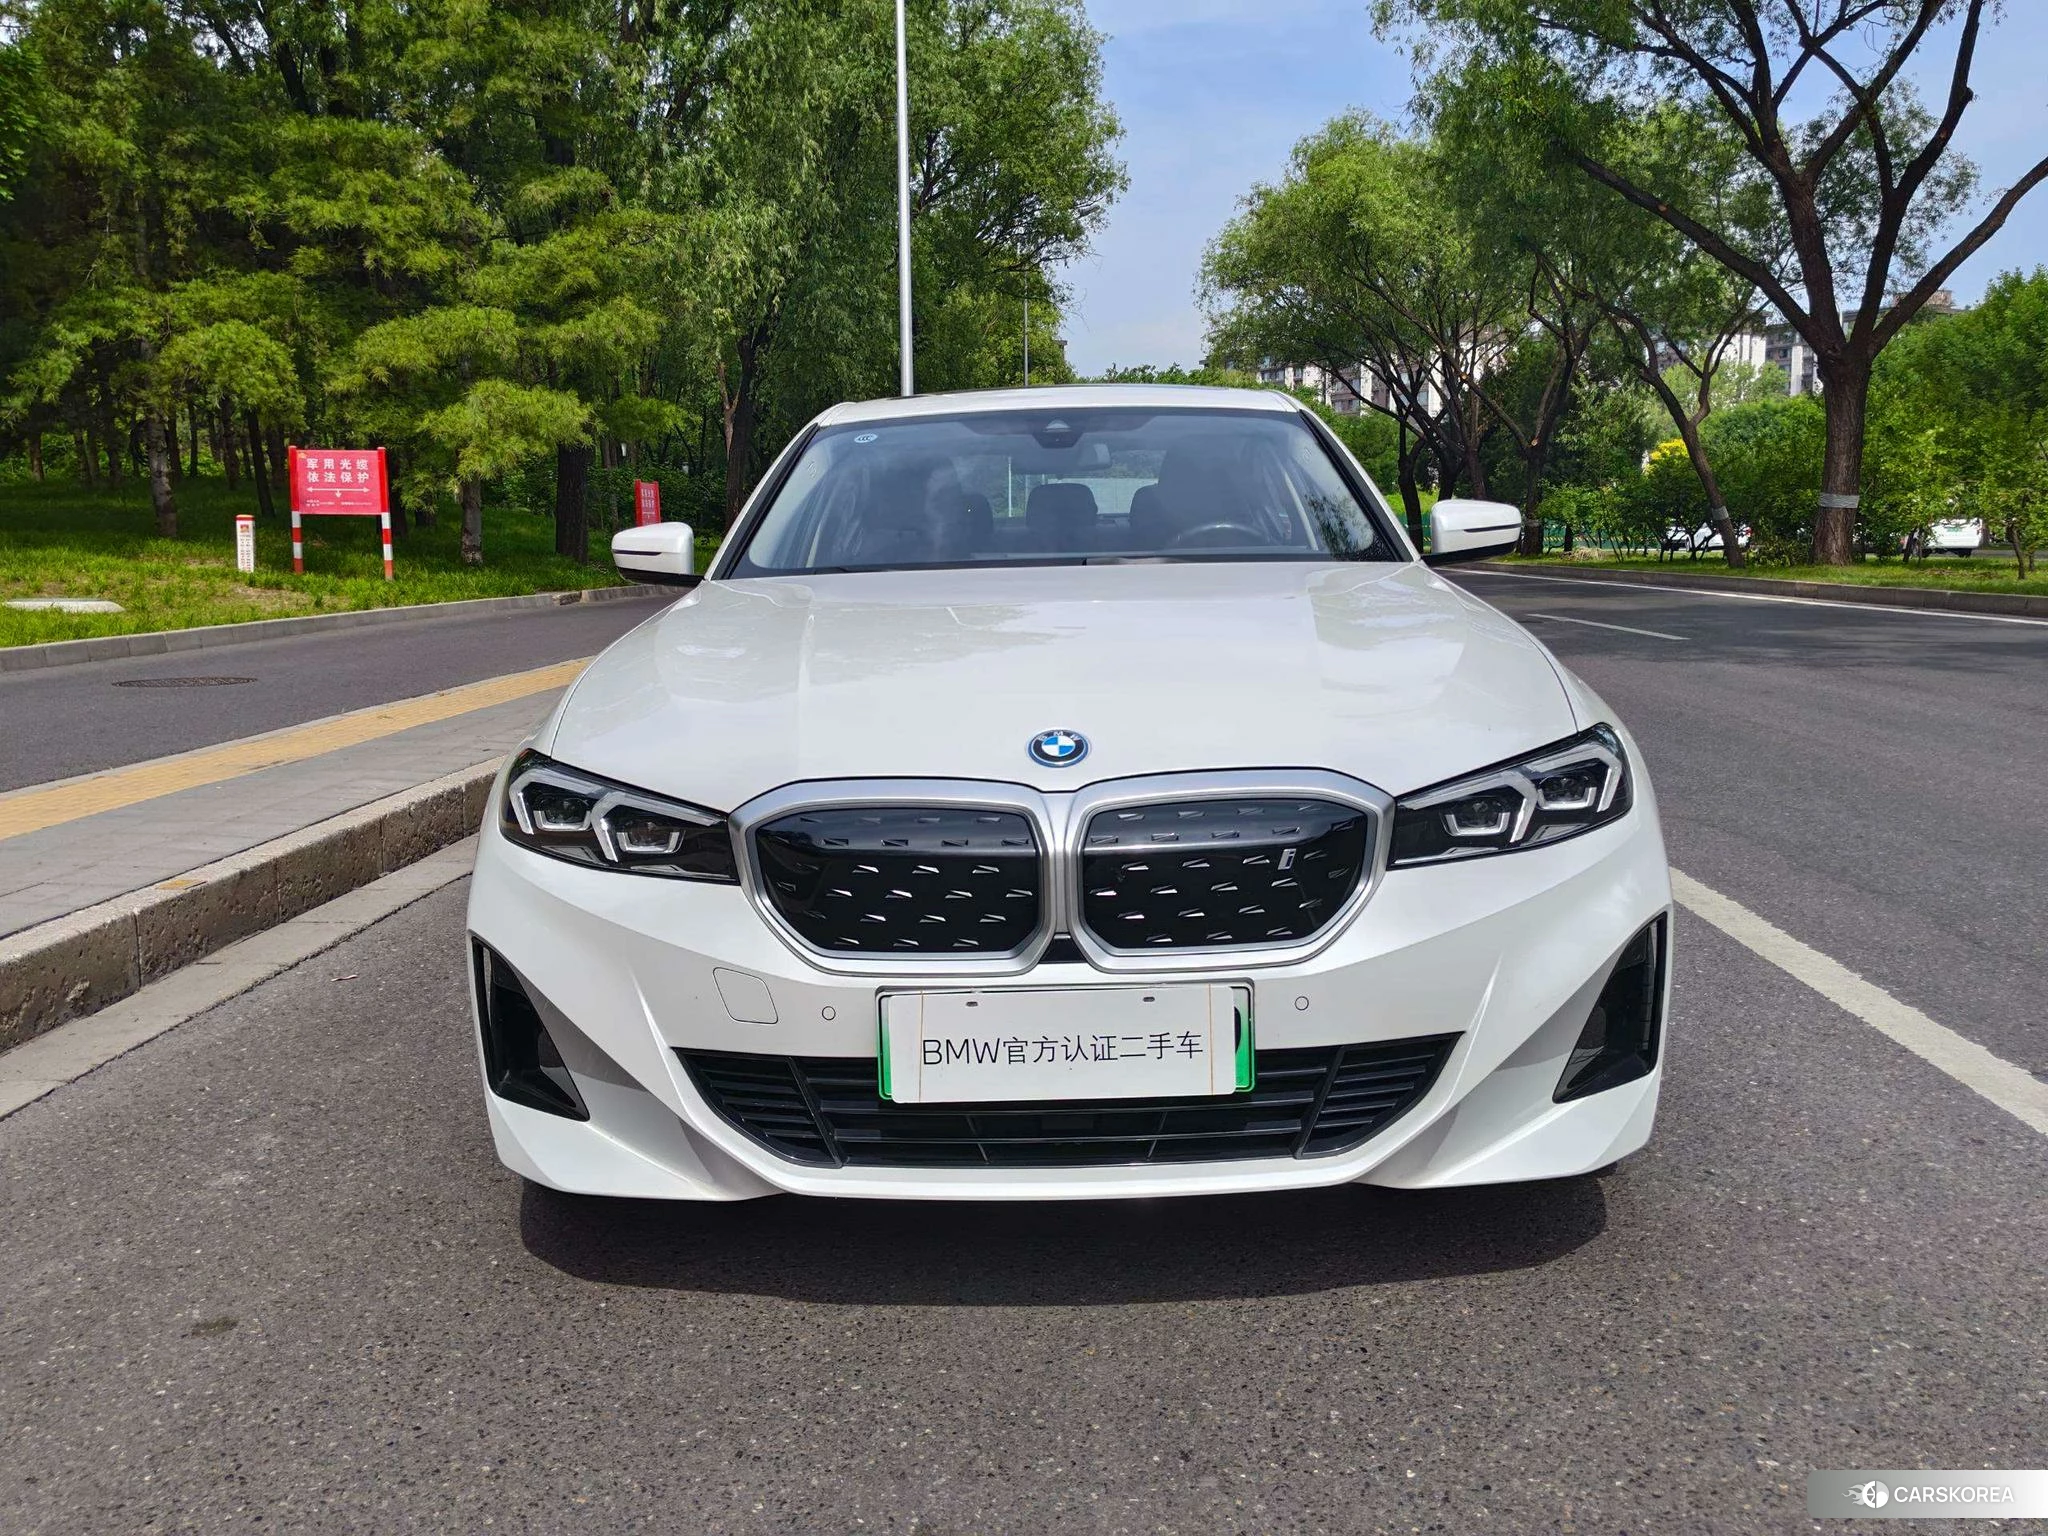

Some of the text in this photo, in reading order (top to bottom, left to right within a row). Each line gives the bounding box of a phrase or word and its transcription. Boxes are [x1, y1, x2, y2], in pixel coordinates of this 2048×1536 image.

[306, 458, 368, 469] 军用光缆
[307, 471, 369, 483] 依法保护
[922, 1031, 1203, 1065] BMW官方认证二手车
